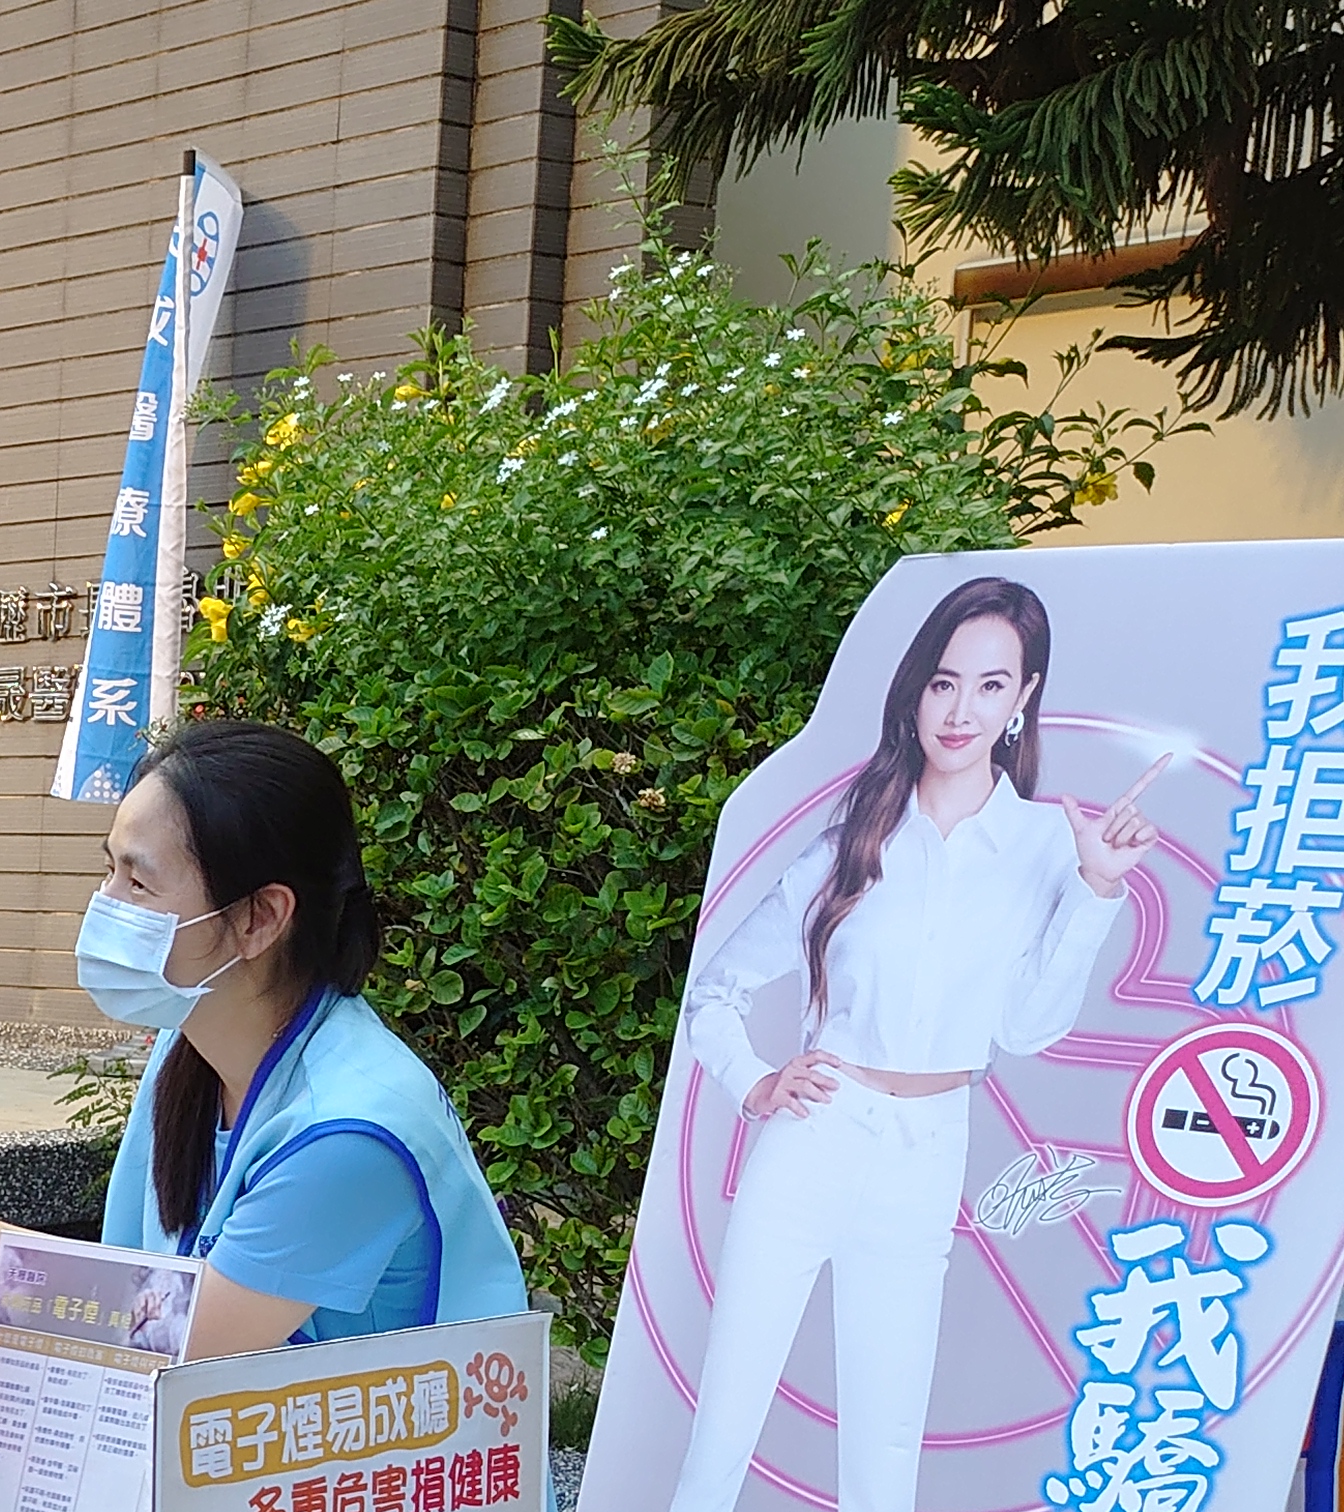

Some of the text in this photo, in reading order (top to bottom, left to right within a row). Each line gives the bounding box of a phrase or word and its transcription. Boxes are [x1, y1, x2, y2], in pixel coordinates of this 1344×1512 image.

[86, 225, 184, 727] 醫療體系
[1195, 611, 1344, 1008] 我拒菸
[188, 1369, 450, 1478] 電子煙易成癮
